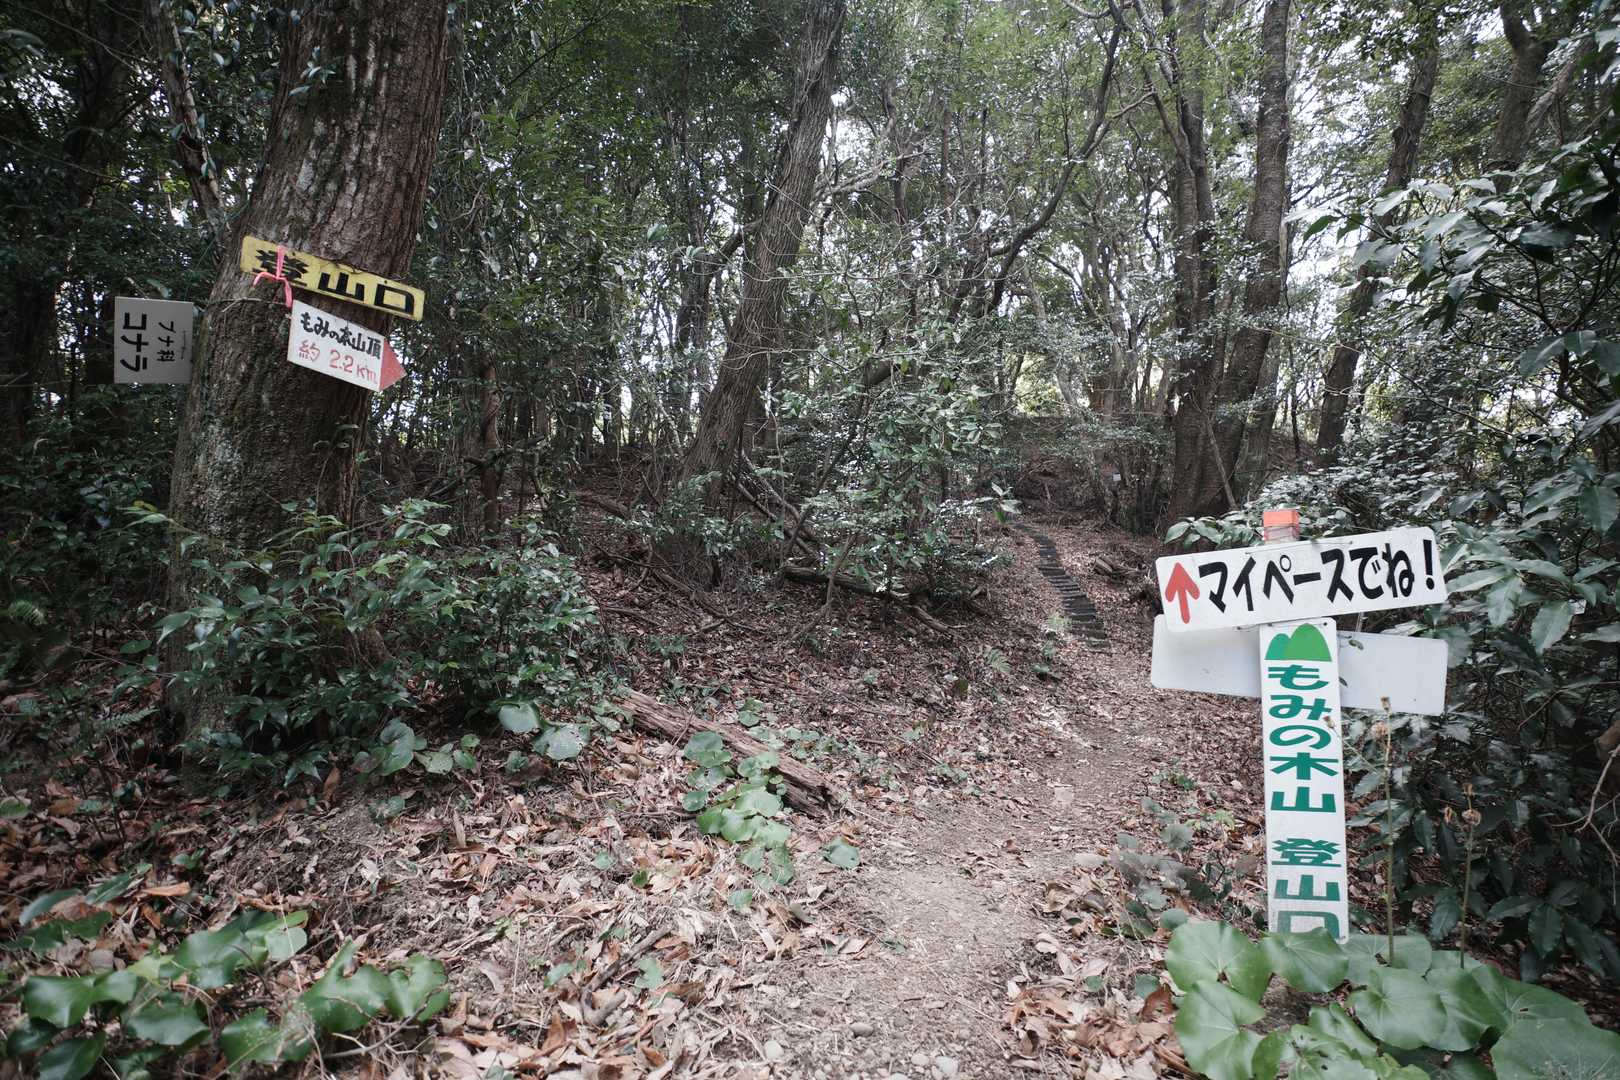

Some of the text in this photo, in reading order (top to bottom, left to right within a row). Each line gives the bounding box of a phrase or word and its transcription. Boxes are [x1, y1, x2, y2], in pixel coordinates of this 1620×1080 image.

[252, 249, 415, 316] 登山口
[120, 312, 149, 372] コナラ
[1267, 664, 1339, 813] もみの木山
